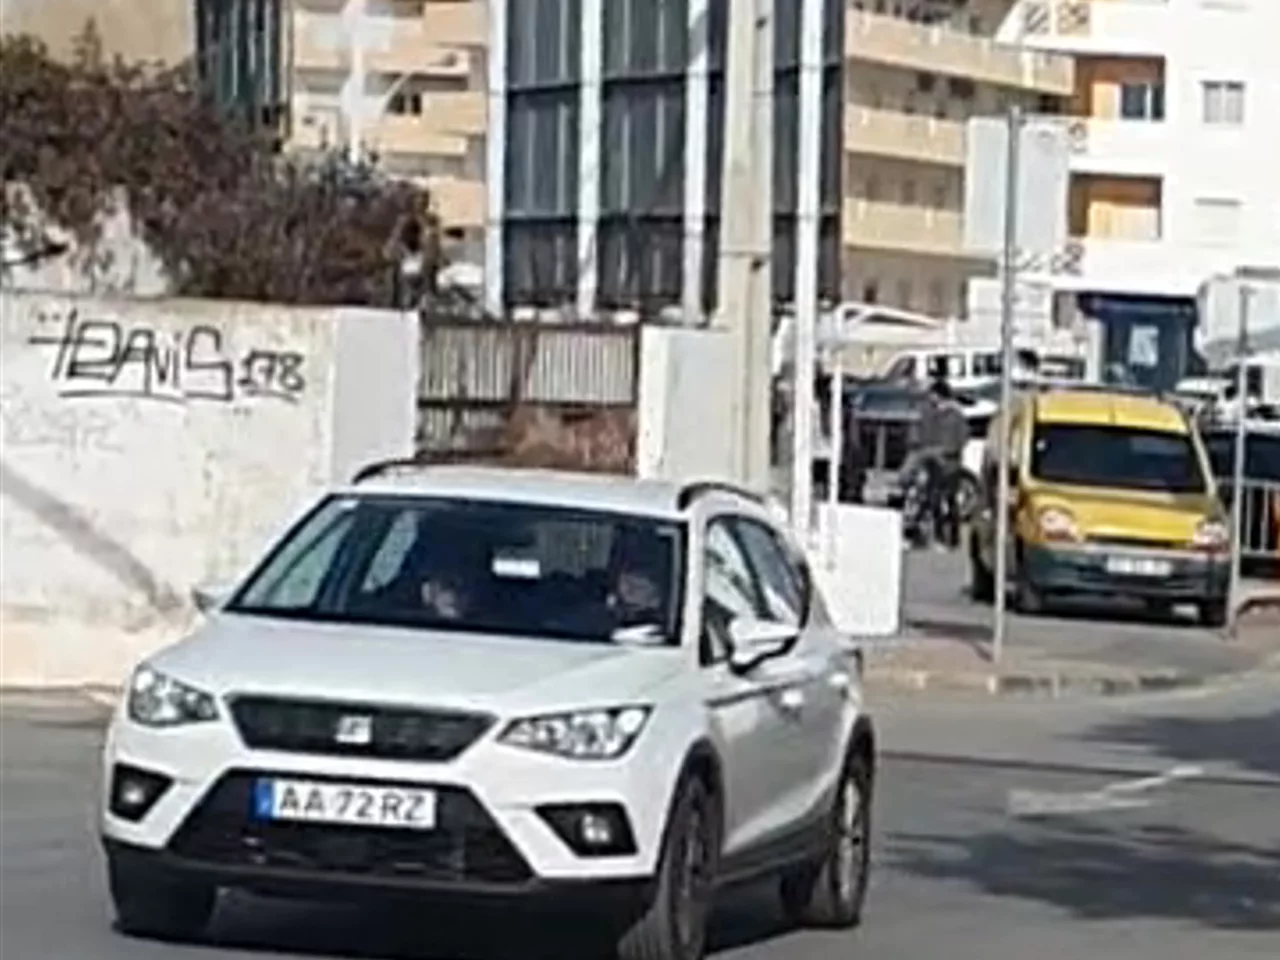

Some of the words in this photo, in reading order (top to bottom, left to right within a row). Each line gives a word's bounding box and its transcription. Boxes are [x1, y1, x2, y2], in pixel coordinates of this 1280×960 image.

[280, 785, 325, 814] AA
[336, 789, 375, 819] 72
[381, 792, 426, 821] RZ
